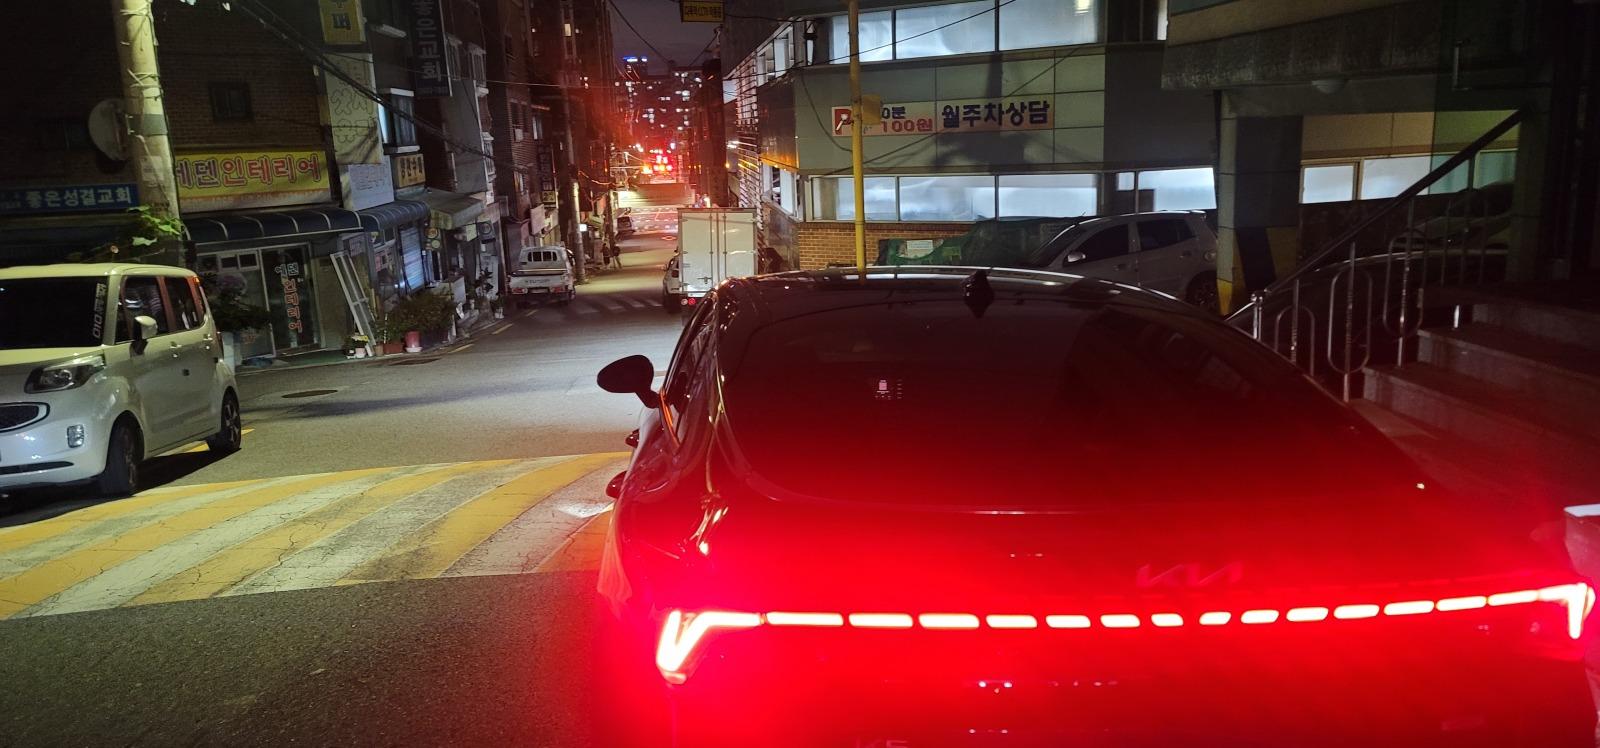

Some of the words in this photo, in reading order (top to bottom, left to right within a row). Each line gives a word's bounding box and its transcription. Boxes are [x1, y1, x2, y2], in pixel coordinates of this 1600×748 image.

[881, 106, 905, 119] 0분
[941, 100, 1050, 129] 월주차상담
[881, 118, 933, 132] 100원
[25, 186, 132, 209] 좋은성결교회
